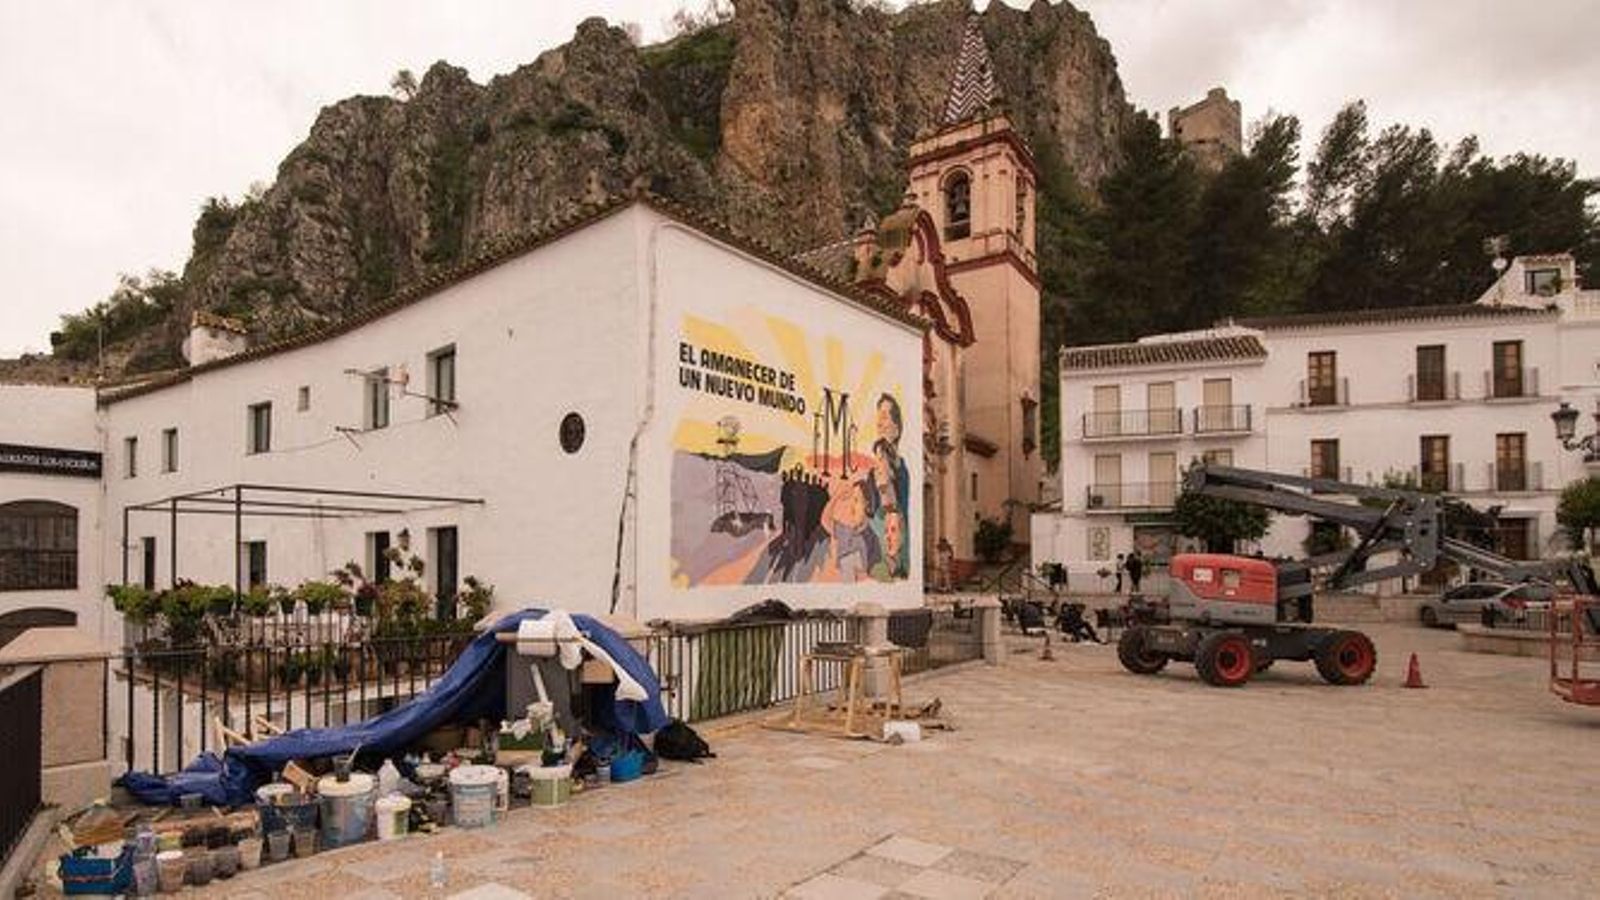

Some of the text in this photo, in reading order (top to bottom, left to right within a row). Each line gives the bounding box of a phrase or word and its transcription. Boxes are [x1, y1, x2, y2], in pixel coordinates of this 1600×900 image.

[679, 342, 796, 391] EL AMANECER DE
[679, 367, 806, 415] UN NUEVO MUNDO
